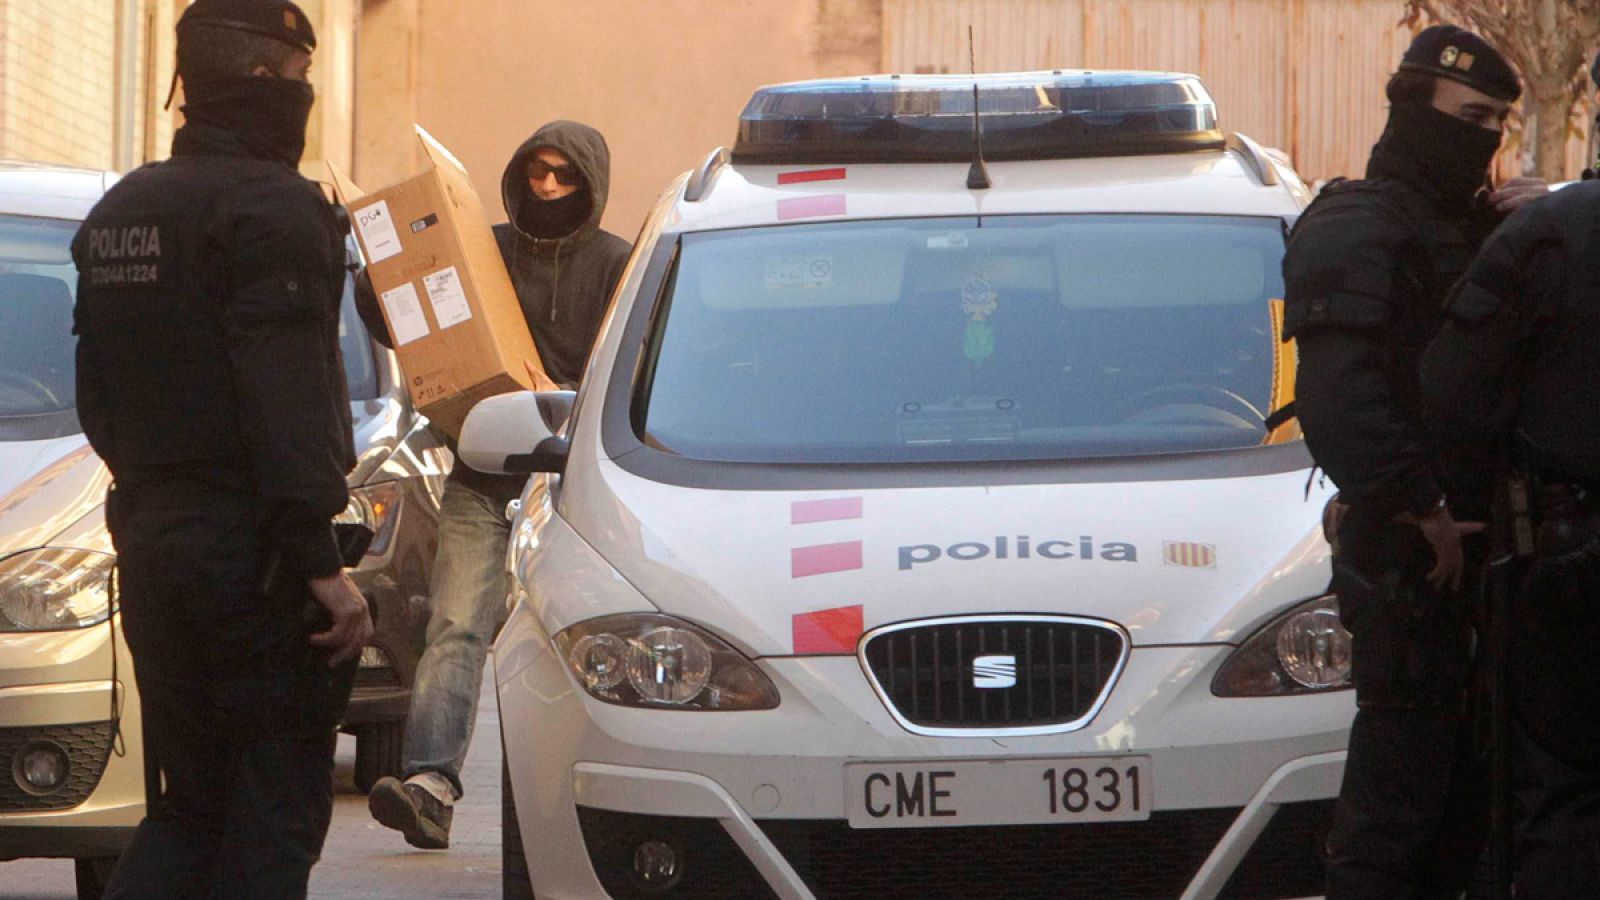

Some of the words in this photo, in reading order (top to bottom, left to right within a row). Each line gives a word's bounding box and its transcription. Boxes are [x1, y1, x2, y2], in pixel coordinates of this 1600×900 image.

[88, 226, 161, 258] POLICIA
[898, 535, 1138, 570] policia
[864, 771, 957, 818] CME
[1043, 766, 1141, 814] 1831
